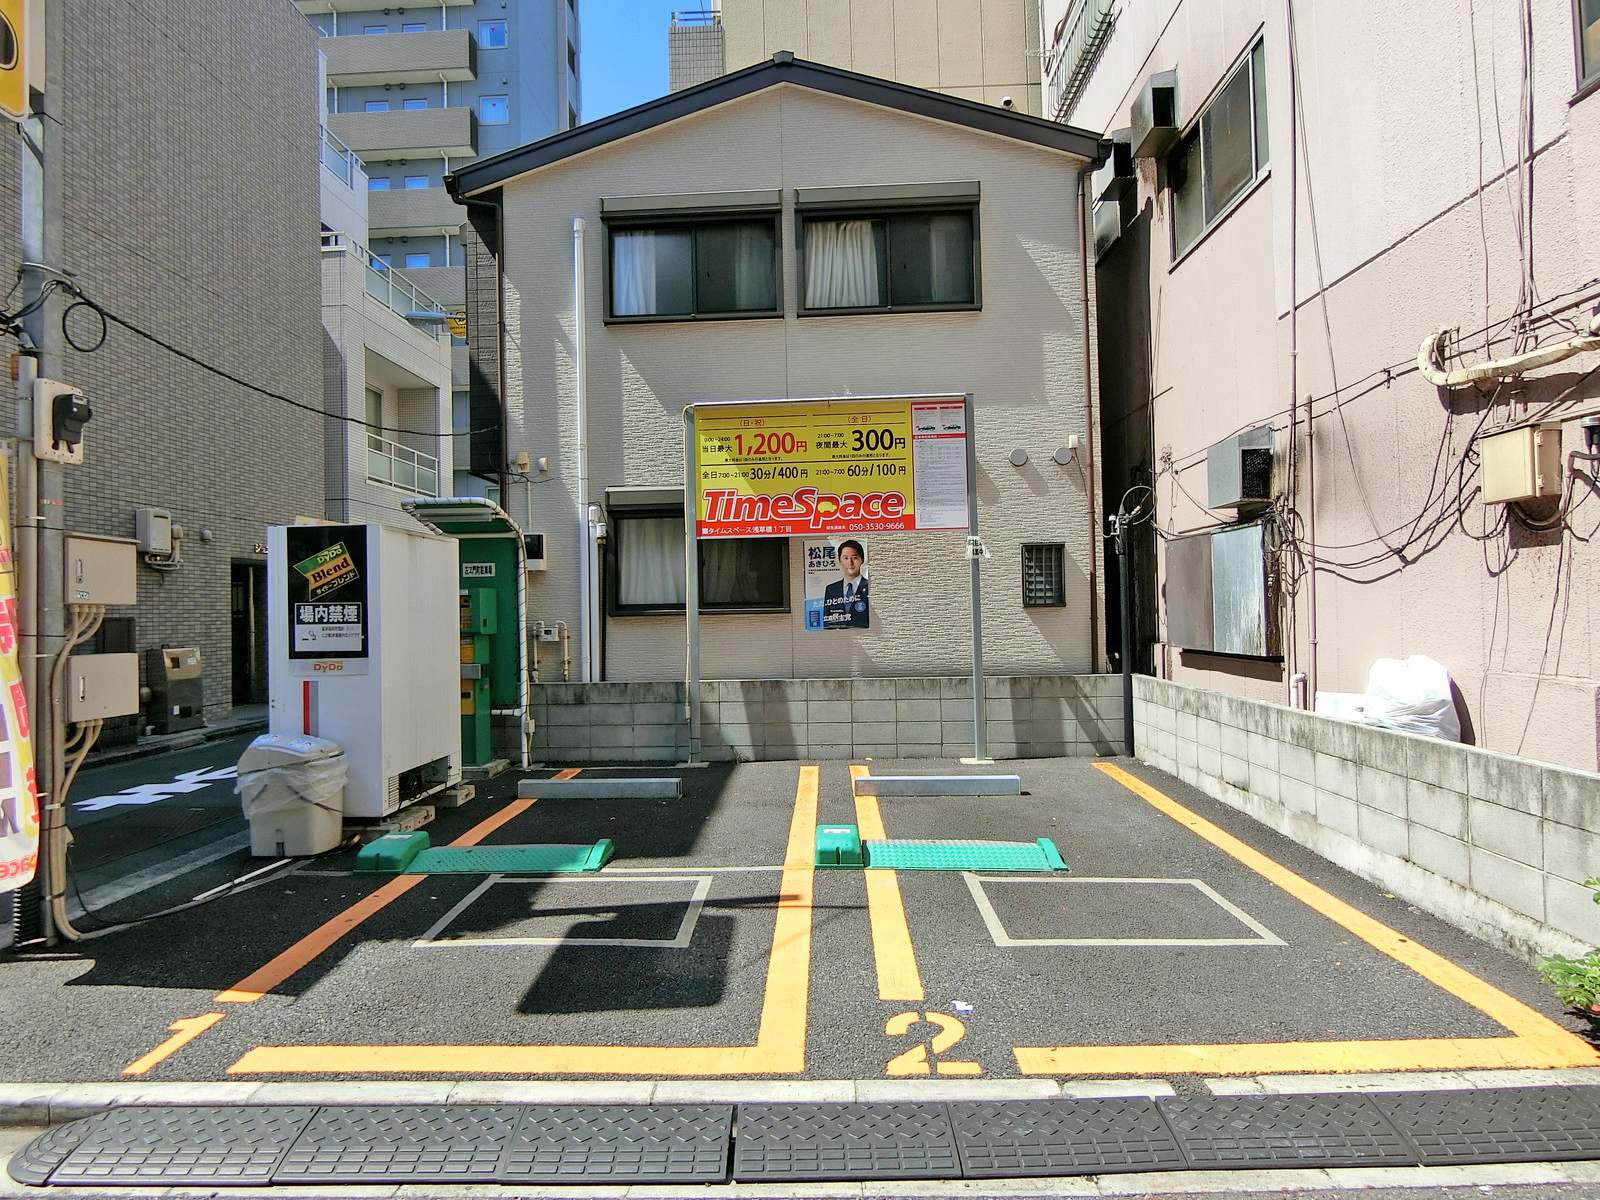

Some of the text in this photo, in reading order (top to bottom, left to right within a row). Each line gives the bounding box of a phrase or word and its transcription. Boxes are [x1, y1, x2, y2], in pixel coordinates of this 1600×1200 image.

[702, 432, 808, 456] 当日最大 1,200円
[815, 428, 906, 452] 夜間最大 300円
[703, 486, 906, 529] TimeSpace
[849, 522, 905, 531] 050-3530-9666
[316, 545, 343, 564] DyDo
[808, 546, 836, 560] 松尾
[311, 557, 351, 583] Blend
[808, 560, 836, 568] あきひろ
[299, 605, 358, 623] 場内禁煙
[313, 661, 344, 672] DyDo
[121, 1011, 227, 1076] 1
[884, 1011, 982, 1077] 2
